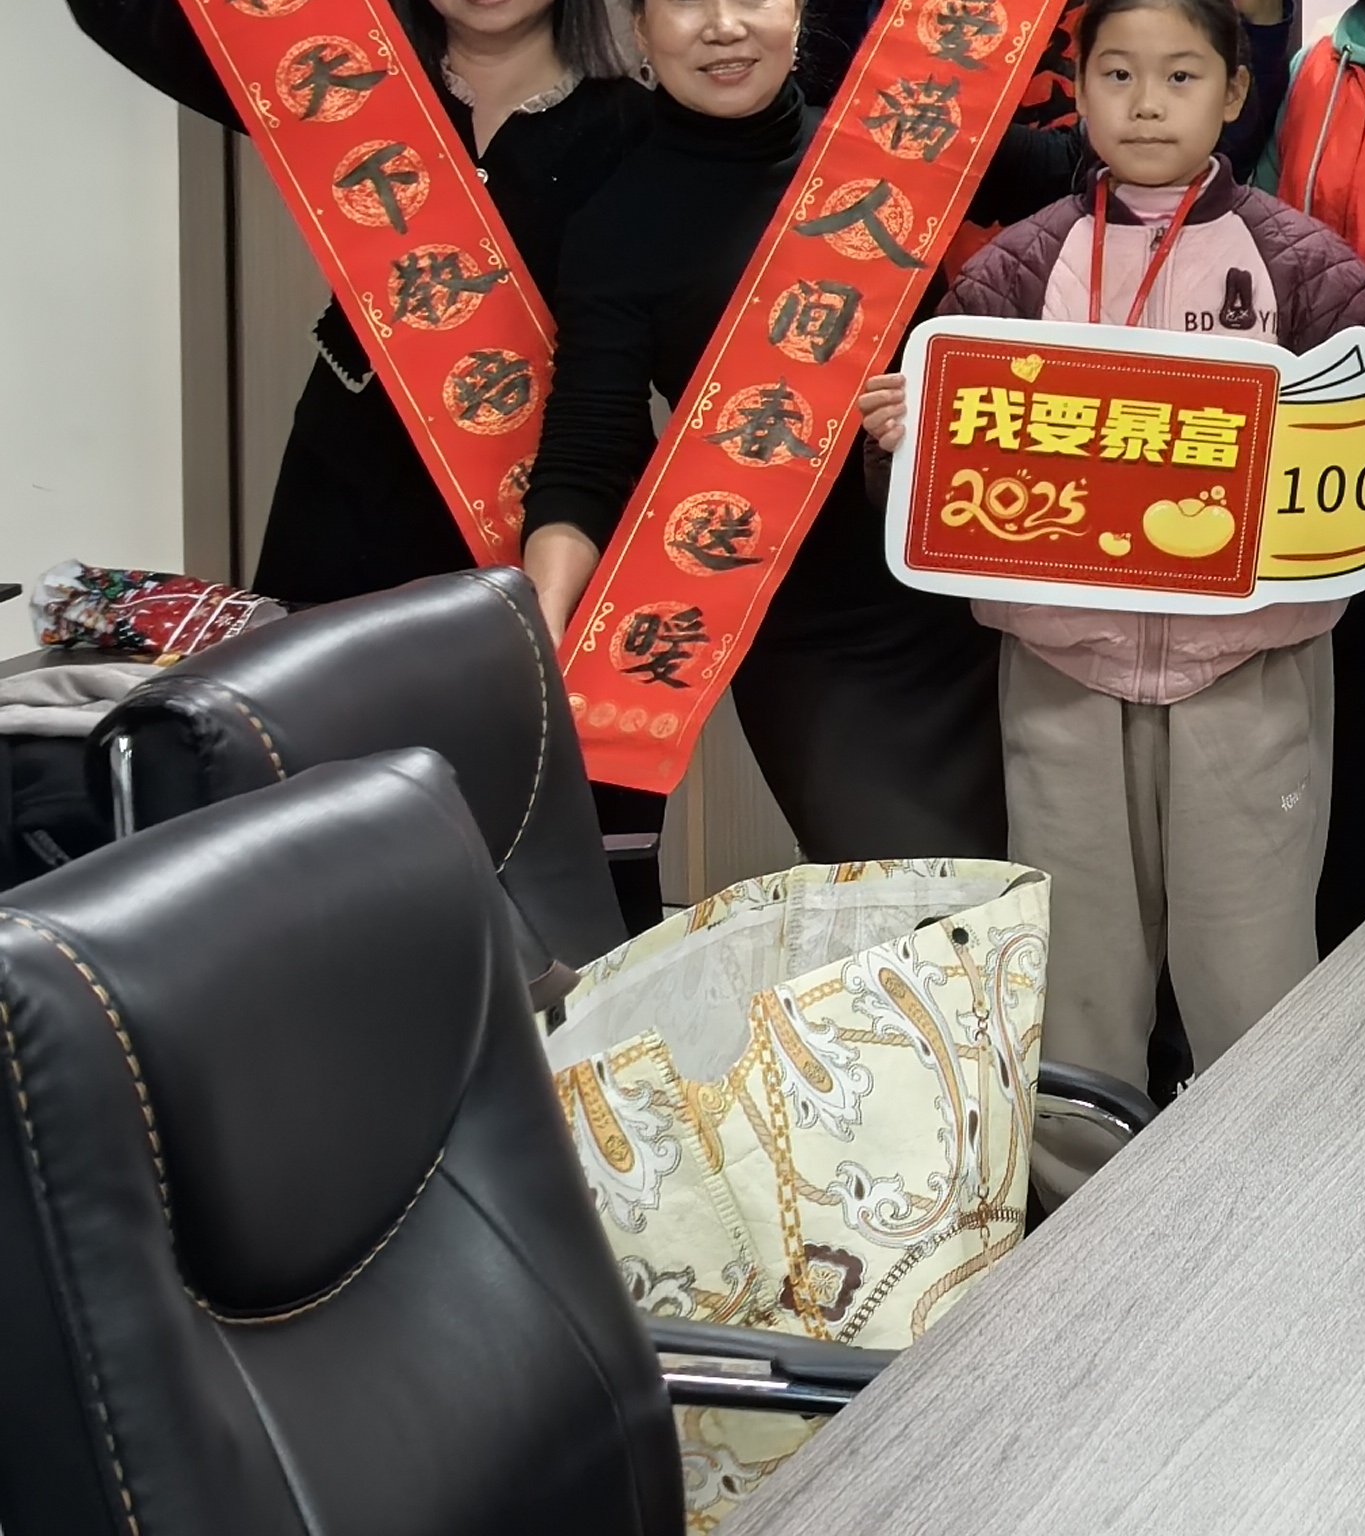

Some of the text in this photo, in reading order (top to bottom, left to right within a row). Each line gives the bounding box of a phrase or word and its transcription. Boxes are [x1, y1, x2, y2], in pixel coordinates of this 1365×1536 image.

[949, 386, 1247, 468] 我要暴富
[941, 468, 1092, 541] 2025
